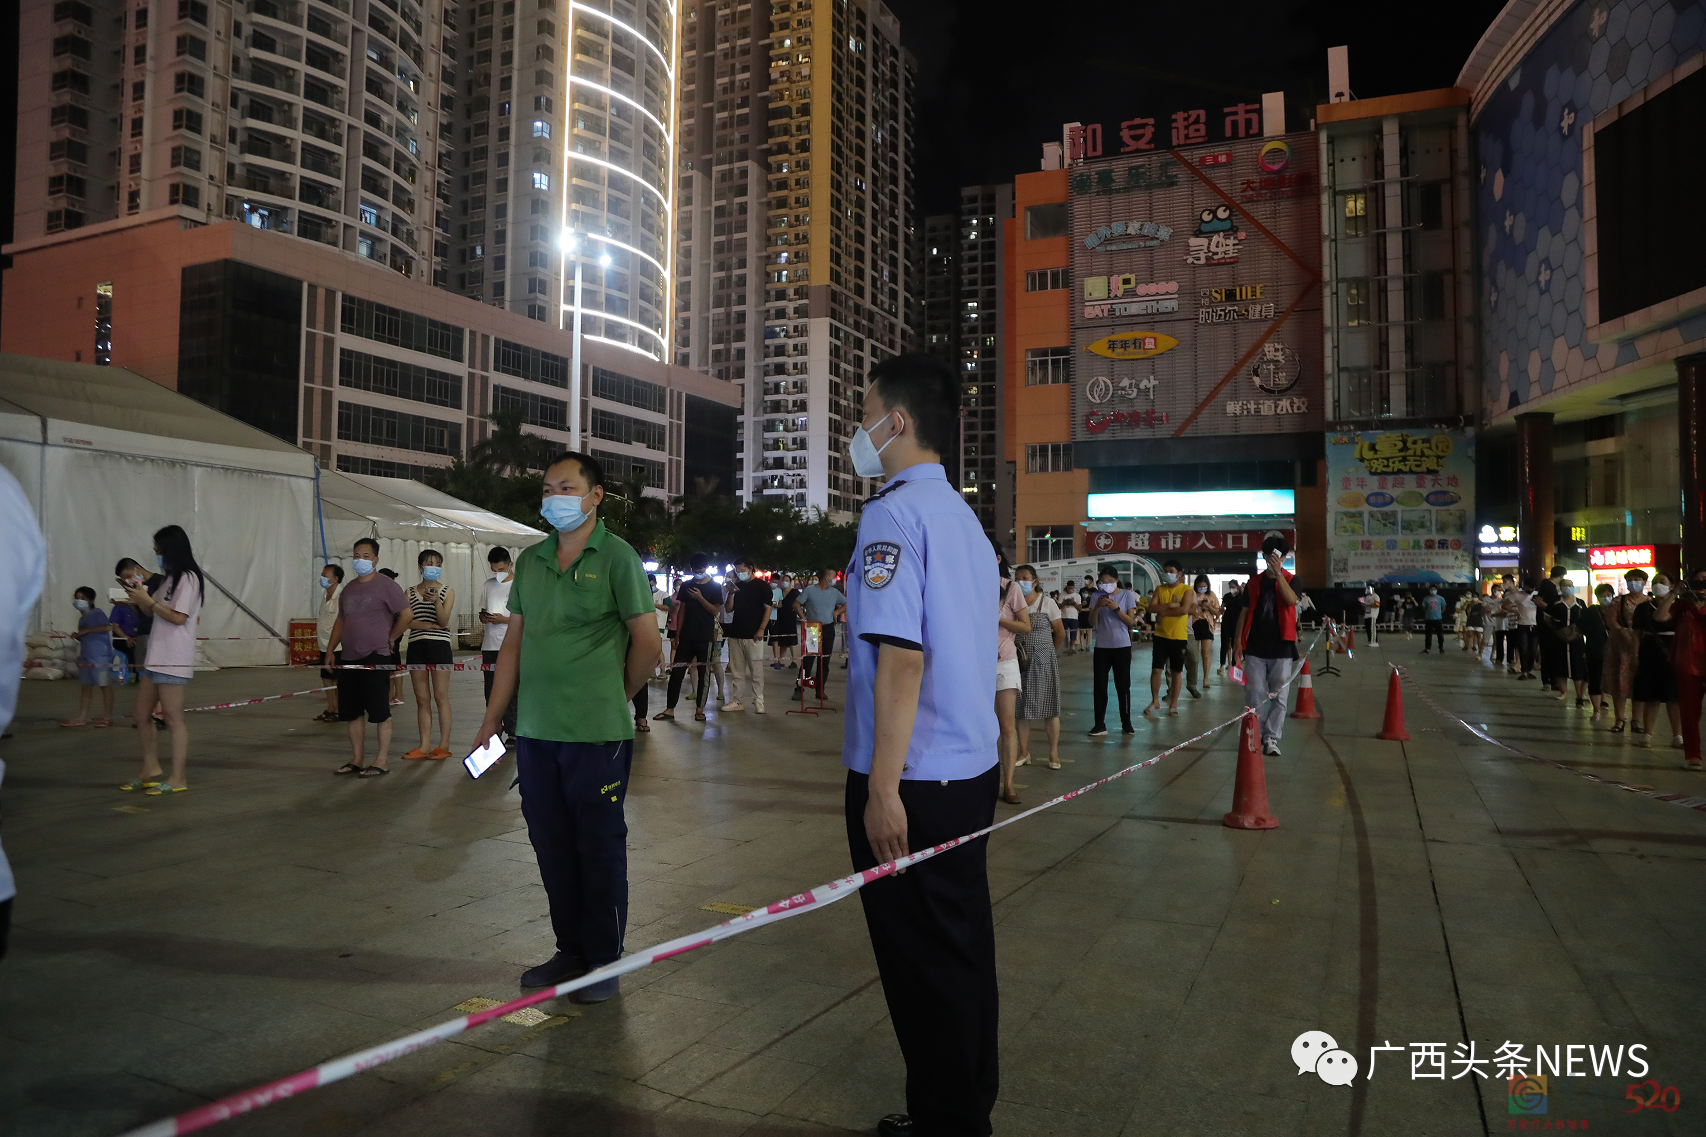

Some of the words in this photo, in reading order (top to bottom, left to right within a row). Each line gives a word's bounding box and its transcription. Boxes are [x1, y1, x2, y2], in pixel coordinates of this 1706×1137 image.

[1069, 103, 1260, 159] 和安超市
[1107, 336, 1157, 351] 年年有鱼
[1354, 433, 1454, 460] 儿童乐园
[1127, 532, 1248, 550] 超市入口
